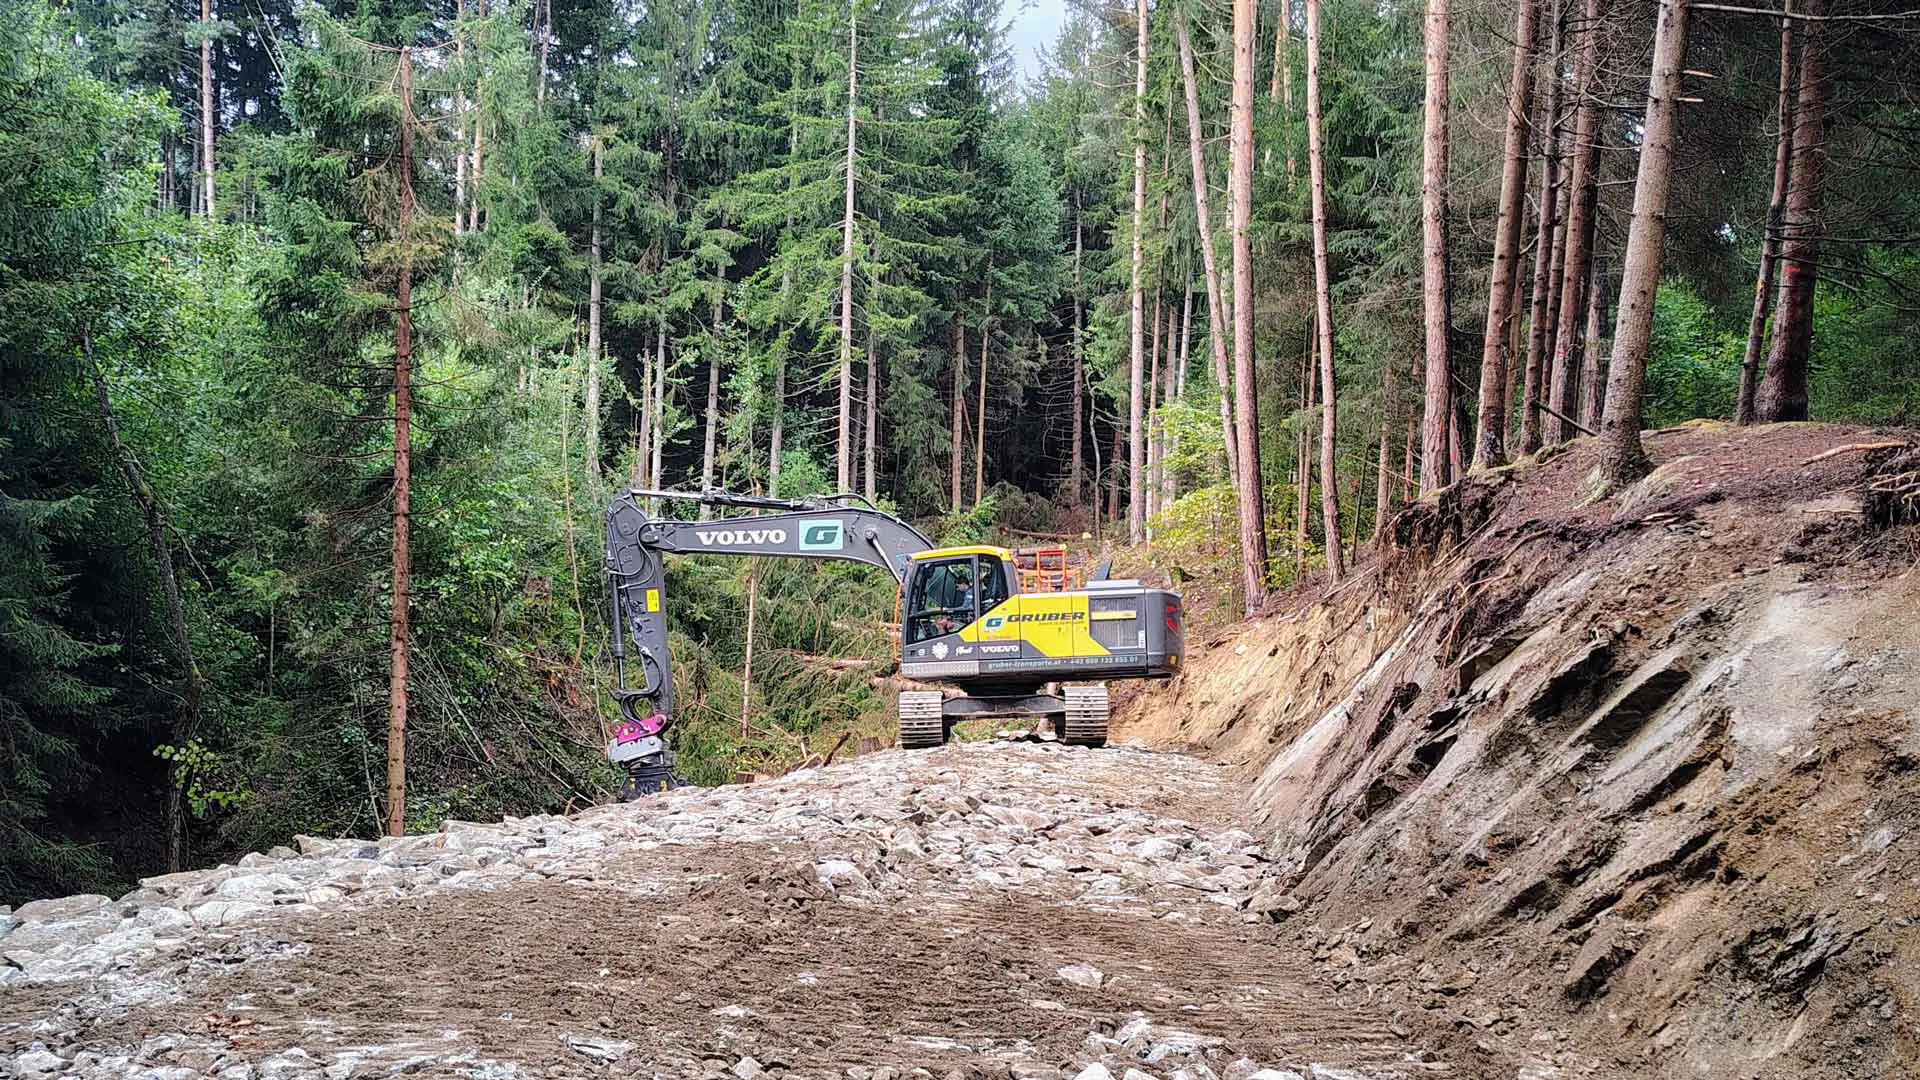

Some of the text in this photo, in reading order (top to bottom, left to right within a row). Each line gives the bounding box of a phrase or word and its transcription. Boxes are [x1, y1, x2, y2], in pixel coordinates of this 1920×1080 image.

[696, 529, 786, 546] VOLVO
[804, 526, 839, 545] G
[986, 617, 1003, 628] G
[1007, 611, 1085, 623] GRUBER
[980, 645, 1019, 653] VOLVO
